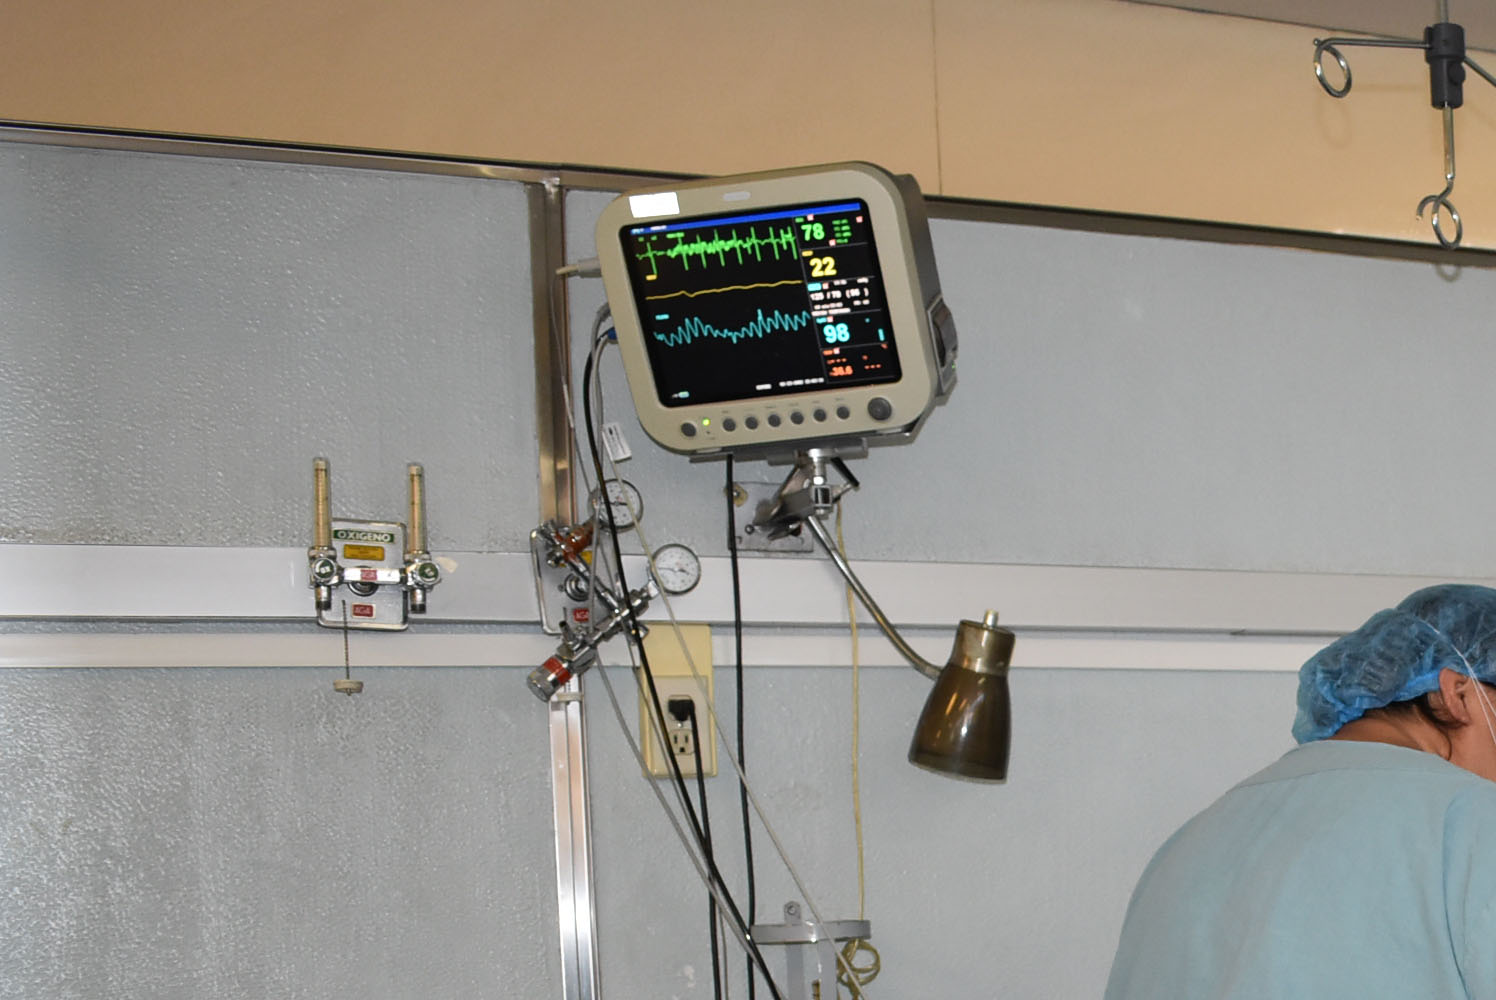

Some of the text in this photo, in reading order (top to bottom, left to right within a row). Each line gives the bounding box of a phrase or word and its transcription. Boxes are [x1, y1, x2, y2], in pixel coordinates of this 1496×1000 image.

[801, 222, 825, 241] 78
[809, 256, 837, 277] 22
[823, 323, 850, 343] 98
[337, 530, 391, 542] OXIGENO
